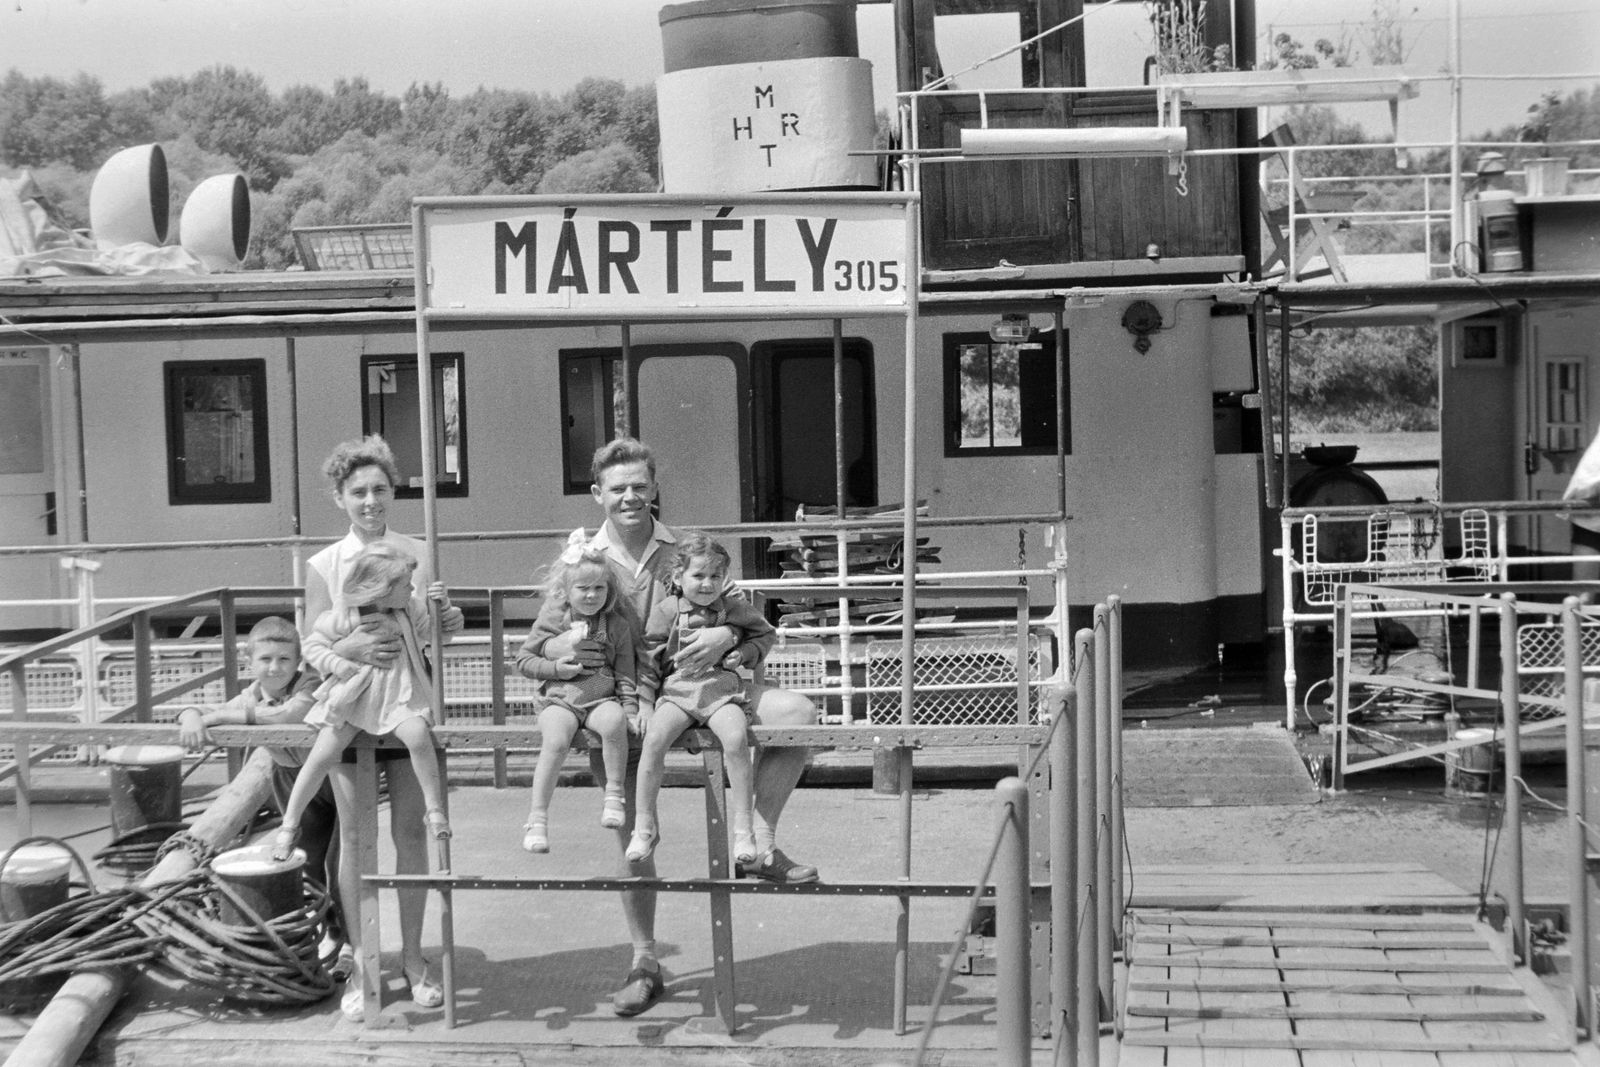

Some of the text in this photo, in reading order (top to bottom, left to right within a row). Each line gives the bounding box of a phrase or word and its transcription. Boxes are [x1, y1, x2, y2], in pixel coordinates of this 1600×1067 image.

[755, 85, 774, 109] M
[733, 113, 801, 141] H R
[759, 144, 778, 168] T
[495, 206, 899, 294] MÁRTÉLY 305
